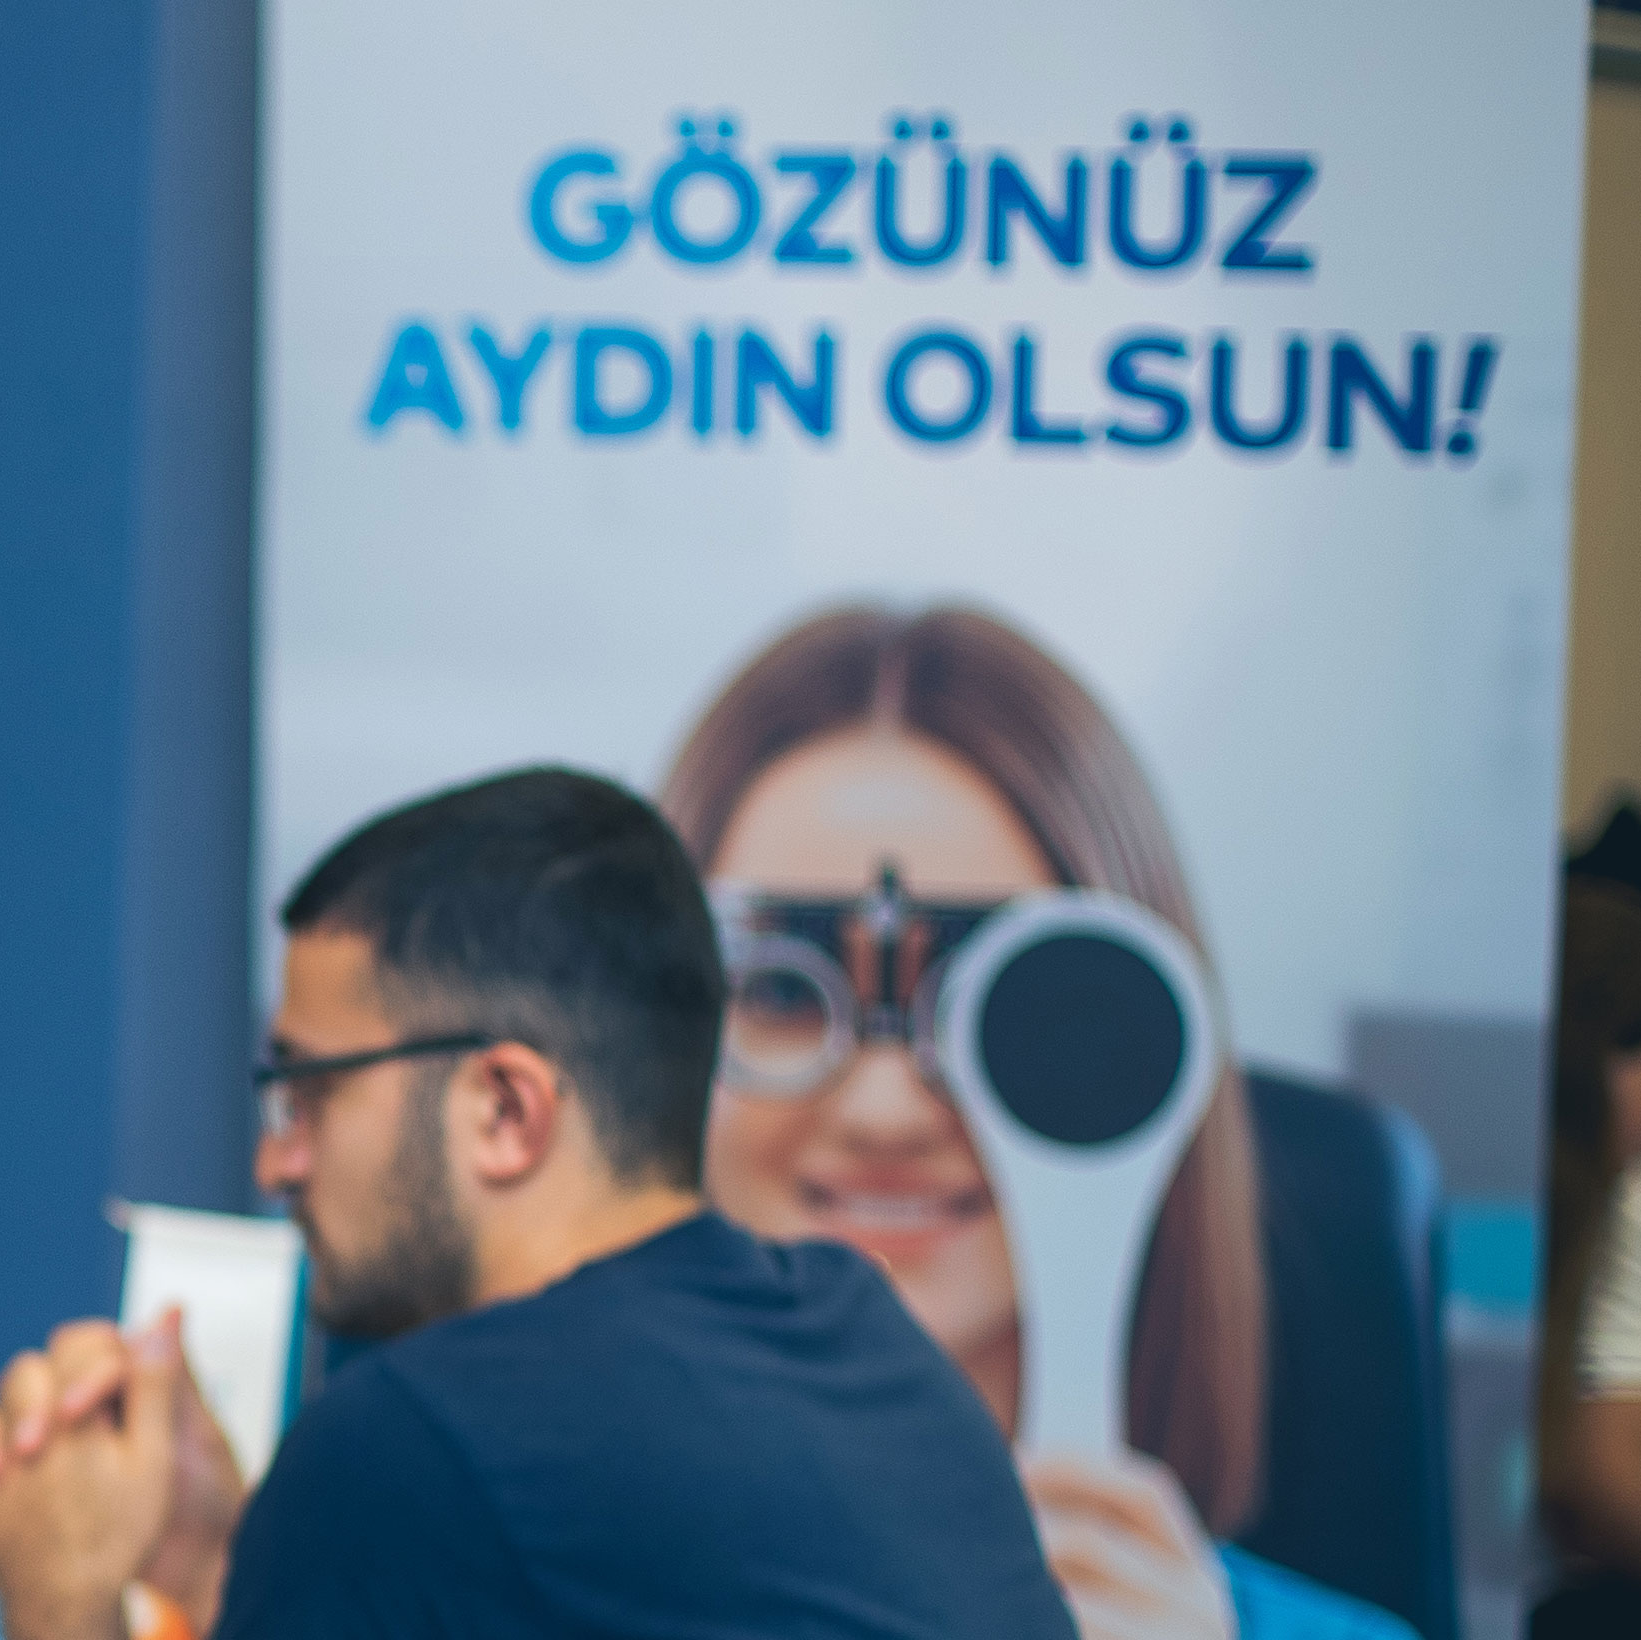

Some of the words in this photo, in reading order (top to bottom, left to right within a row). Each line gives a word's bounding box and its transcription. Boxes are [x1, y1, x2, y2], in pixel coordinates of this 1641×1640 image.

[526, 115, 1319, 276] GÖZÜNÜZ
[365, 321, 836, 440] AYDIN
[883, 329, 1499, 461] OLSUN!
